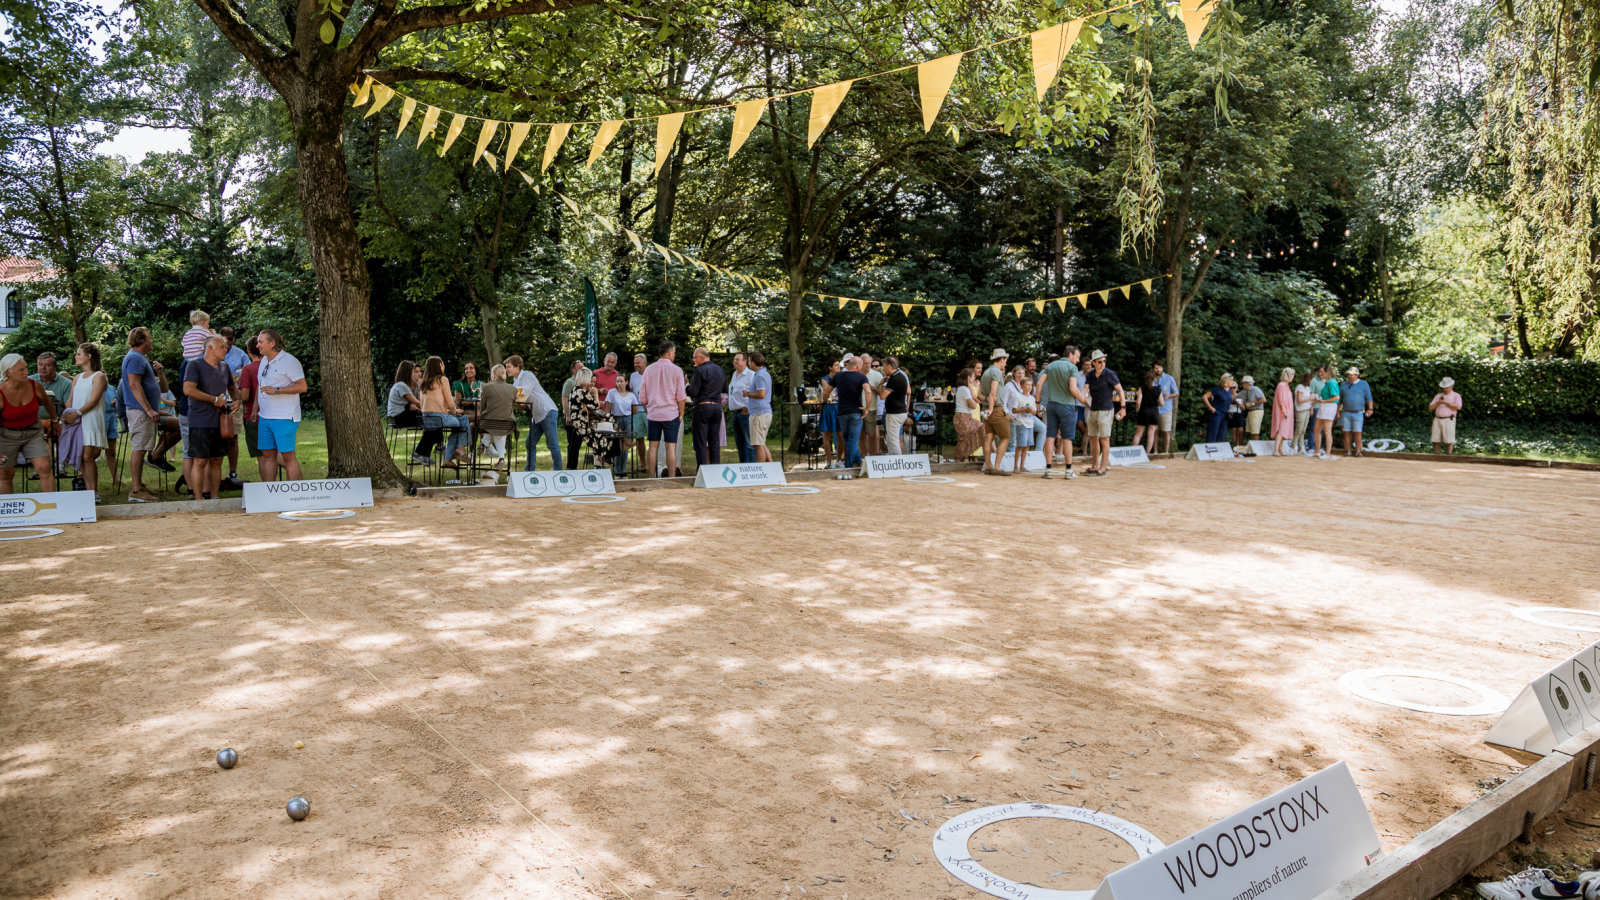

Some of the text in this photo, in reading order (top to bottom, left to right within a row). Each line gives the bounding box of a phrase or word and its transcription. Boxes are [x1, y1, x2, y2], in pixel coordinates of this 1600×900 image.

[871, 458, 924, 474] liquidfloors
[266, 480, 351, 493] WOODSTOXX
[0, 501, 25, 509] JNEN
[944, 805, 1016, 833] WOODSTOXX
[1071, 808, 1157, 845] WOODSTOXX
[1163, 785, 1329, 894] WOODSTOXX
[943, 855, 1030, 900] WOODSTOXX
[1271, 866, 1282, 885] of
[1280, 856, 1309, 880] nature
